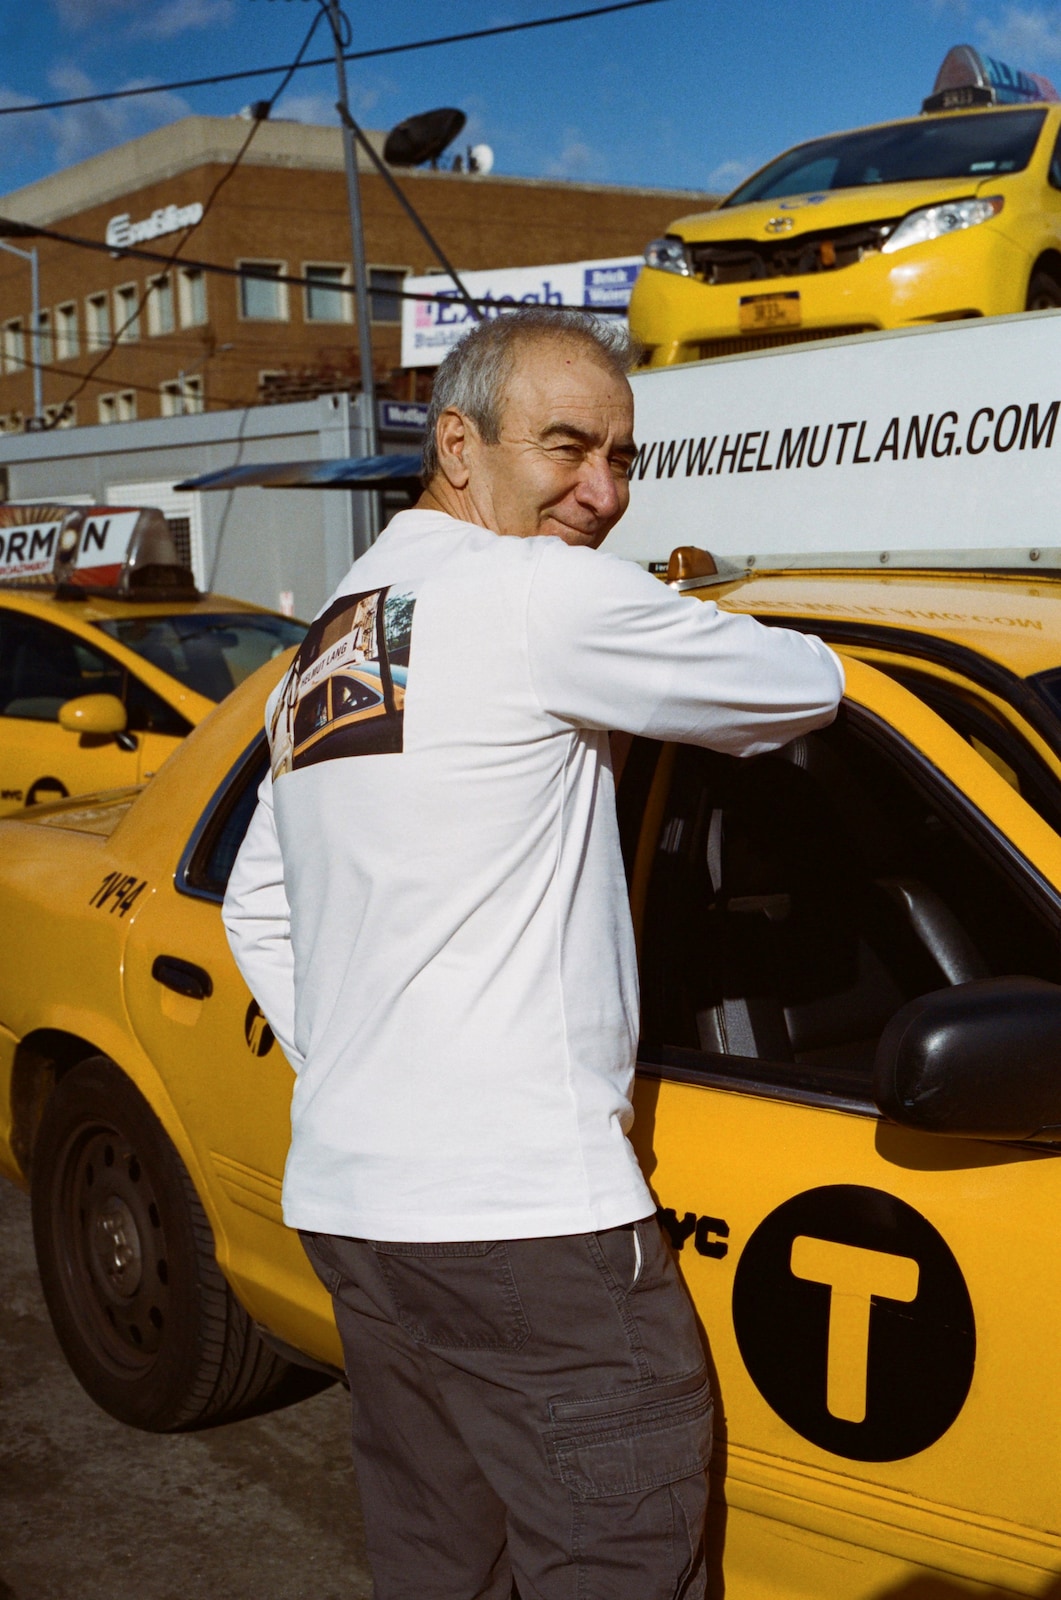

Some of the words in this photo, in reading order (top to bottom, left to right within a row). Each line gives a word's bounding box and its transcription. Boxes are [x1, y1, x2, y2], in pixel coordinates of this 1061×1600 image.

[628, 401, 1061, 481] WWW.HELMUTLANG.COM
[300, 658, 326, 688] HELMUT
[326, 641, 348, 666] LANG
[89, 871, 148, 918] 1V94
[790, 1235, 920, 1424] T
